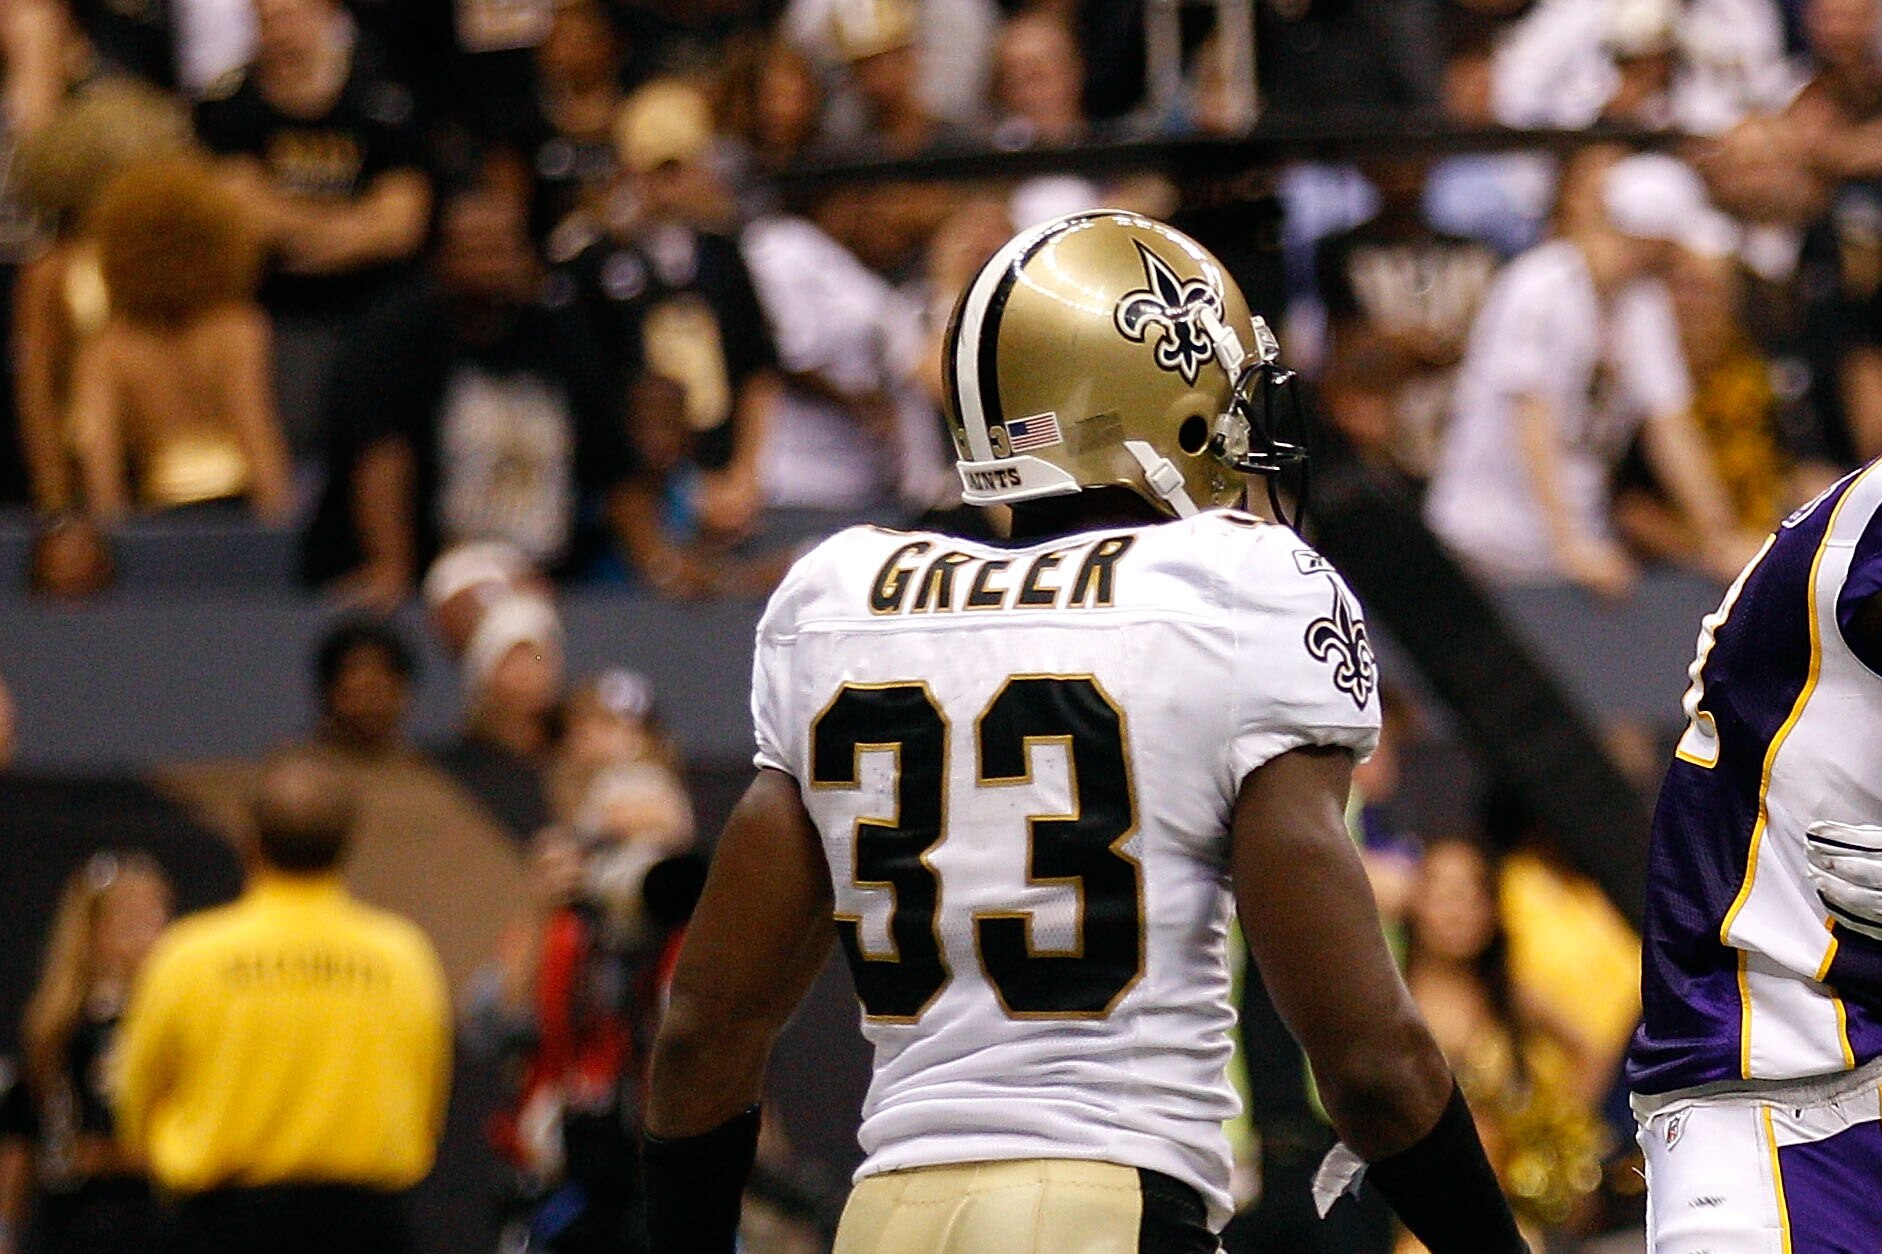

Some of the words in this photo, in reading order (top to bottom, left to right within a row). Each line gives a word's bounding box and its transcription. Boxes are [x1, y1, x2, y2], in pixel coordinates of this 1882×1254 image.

[965, 468, 1021, 490] AINTS
[868, 534, 1139, 615] GREER
[810, 673, 1146, 1024] 33
